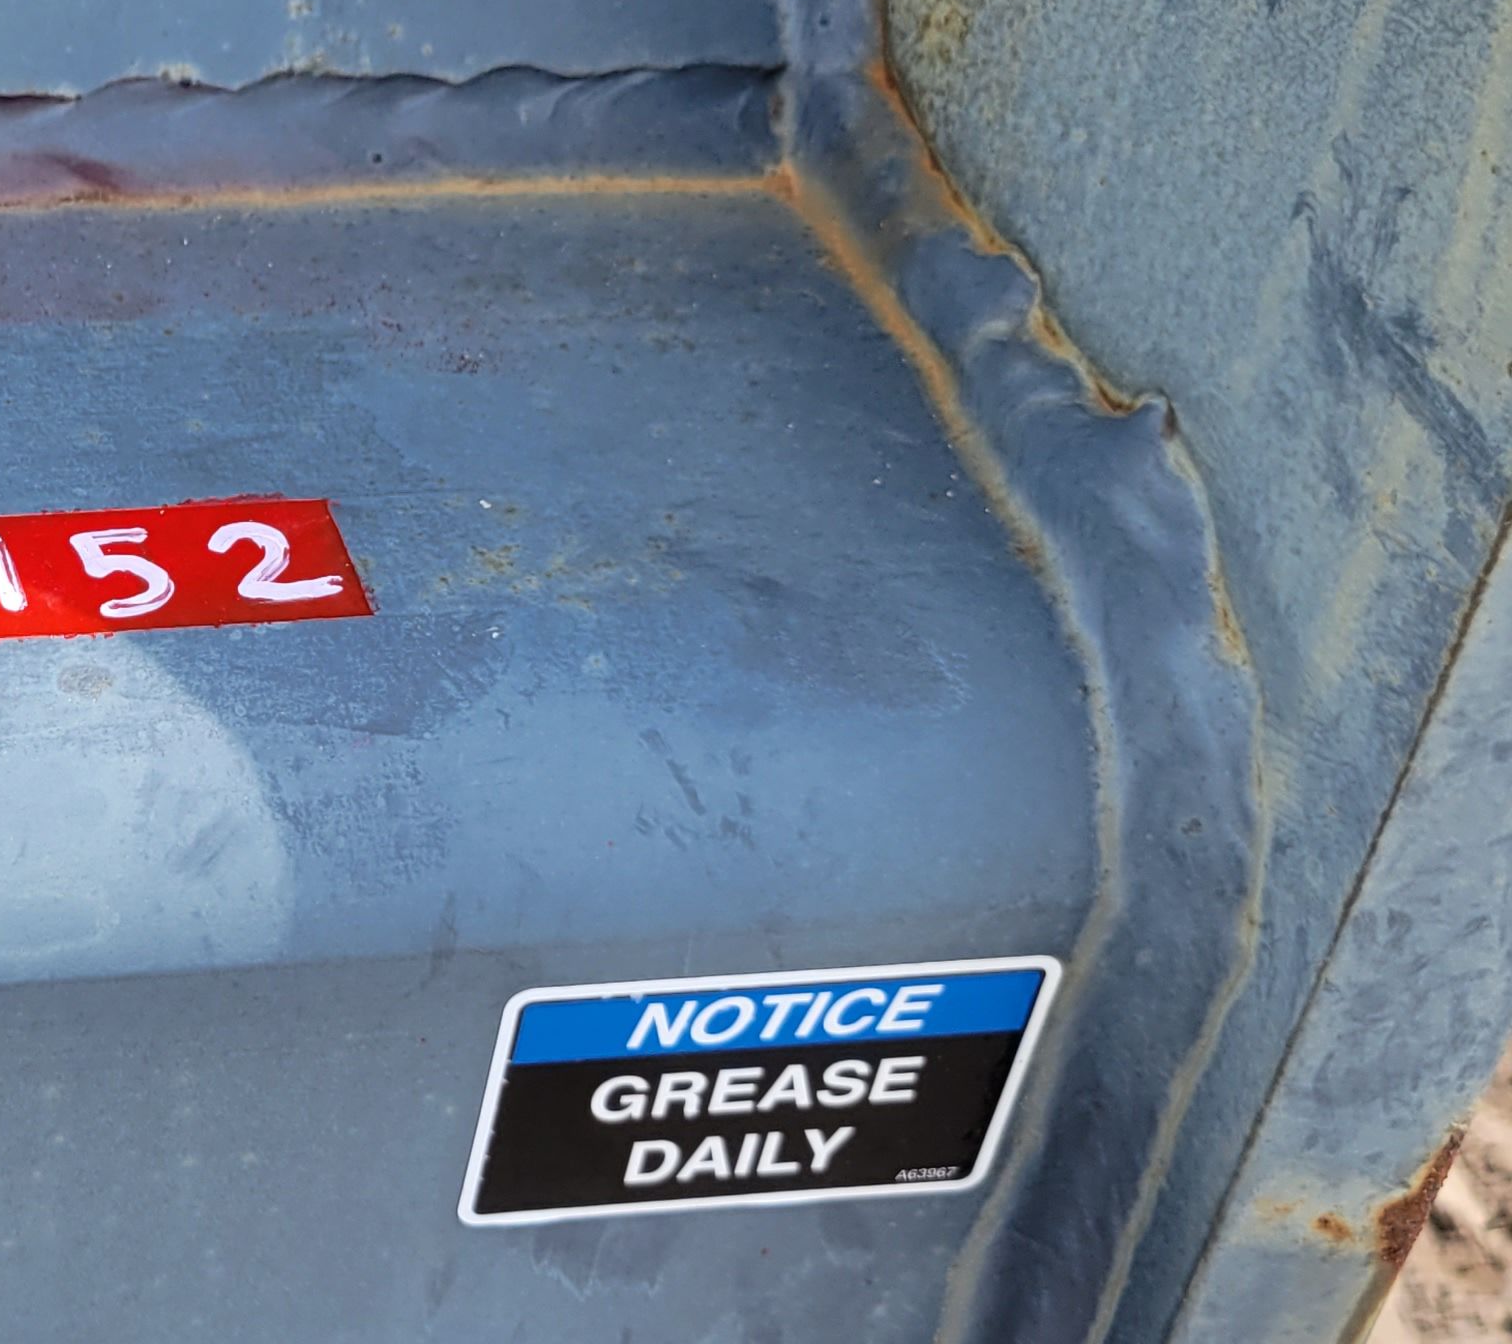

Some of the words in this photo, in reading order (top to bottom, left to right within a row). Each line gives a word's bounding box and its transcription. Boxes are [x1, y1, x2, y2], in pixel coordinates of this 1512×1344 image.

[626, 983, 946, 1050] NOTICE
[589, 1055, 927, 1124] GREASE
[623, 1126, 857, 1188] DAILY
